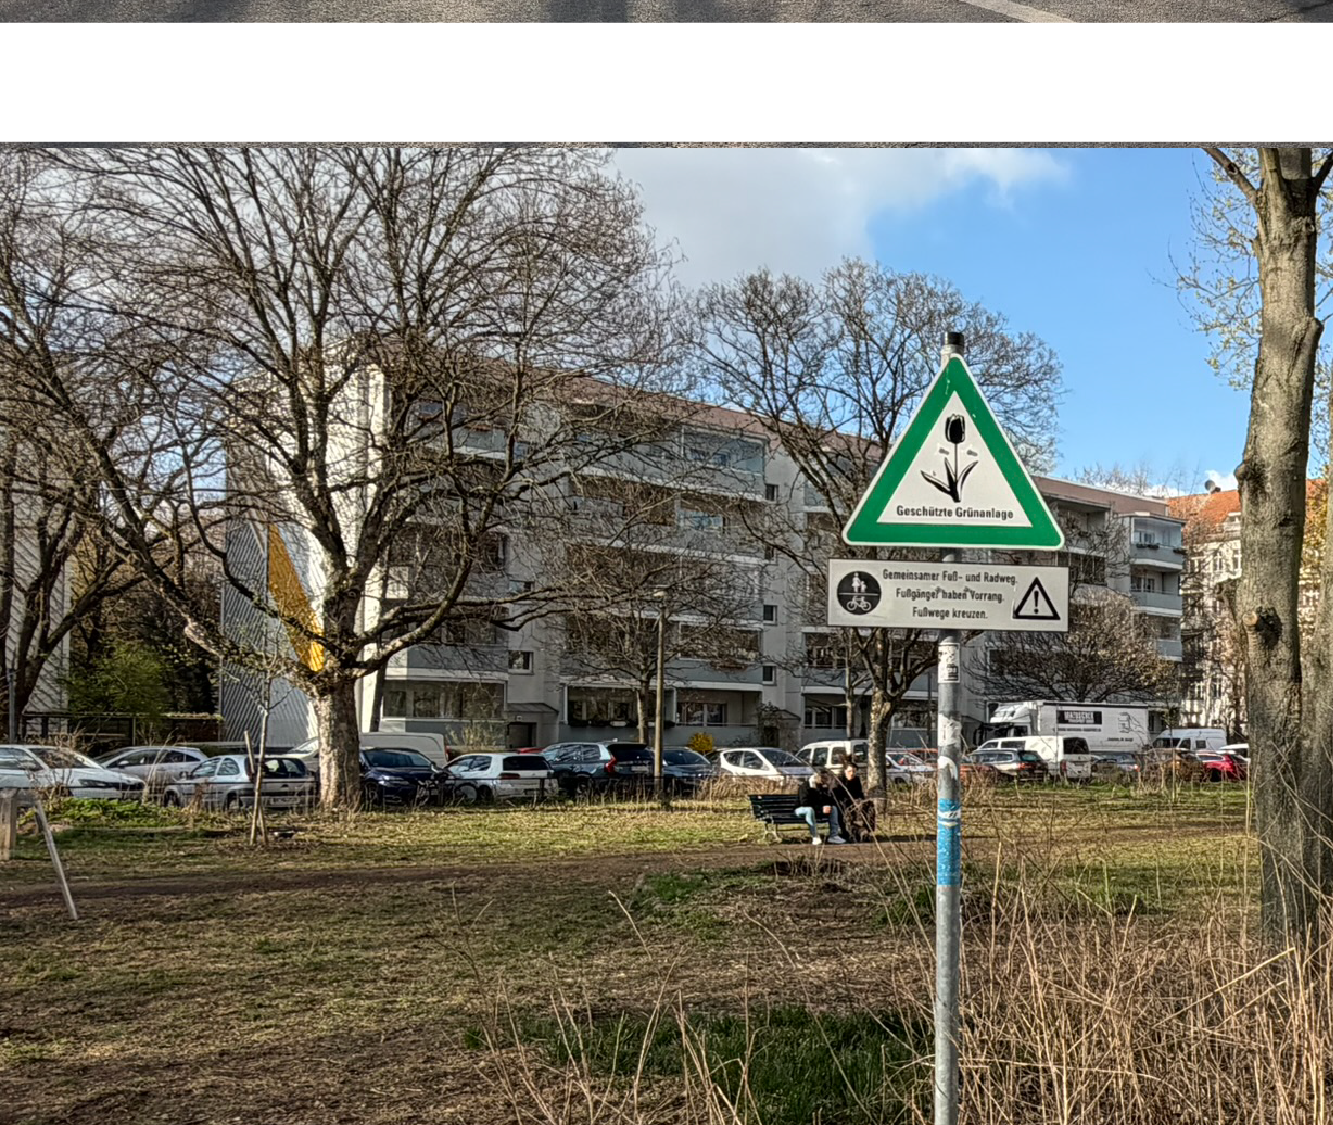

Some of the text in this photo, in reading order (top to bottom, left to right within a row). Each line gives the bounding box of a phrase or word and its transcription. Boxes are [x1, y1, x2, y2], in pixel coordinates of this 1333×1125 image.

[896, 504, 1014, 521] Geschützte Grünanlage
[882, 568, 940, 581] Gemeinsamer
[942, 570, 963, 582] Fuß-
[965, 572, 981, 583] und
[896, 587, 940, 602] Fußgänger
[941, 589, 967, 600] haben
[912, 606, 950, 620] Fußwege
